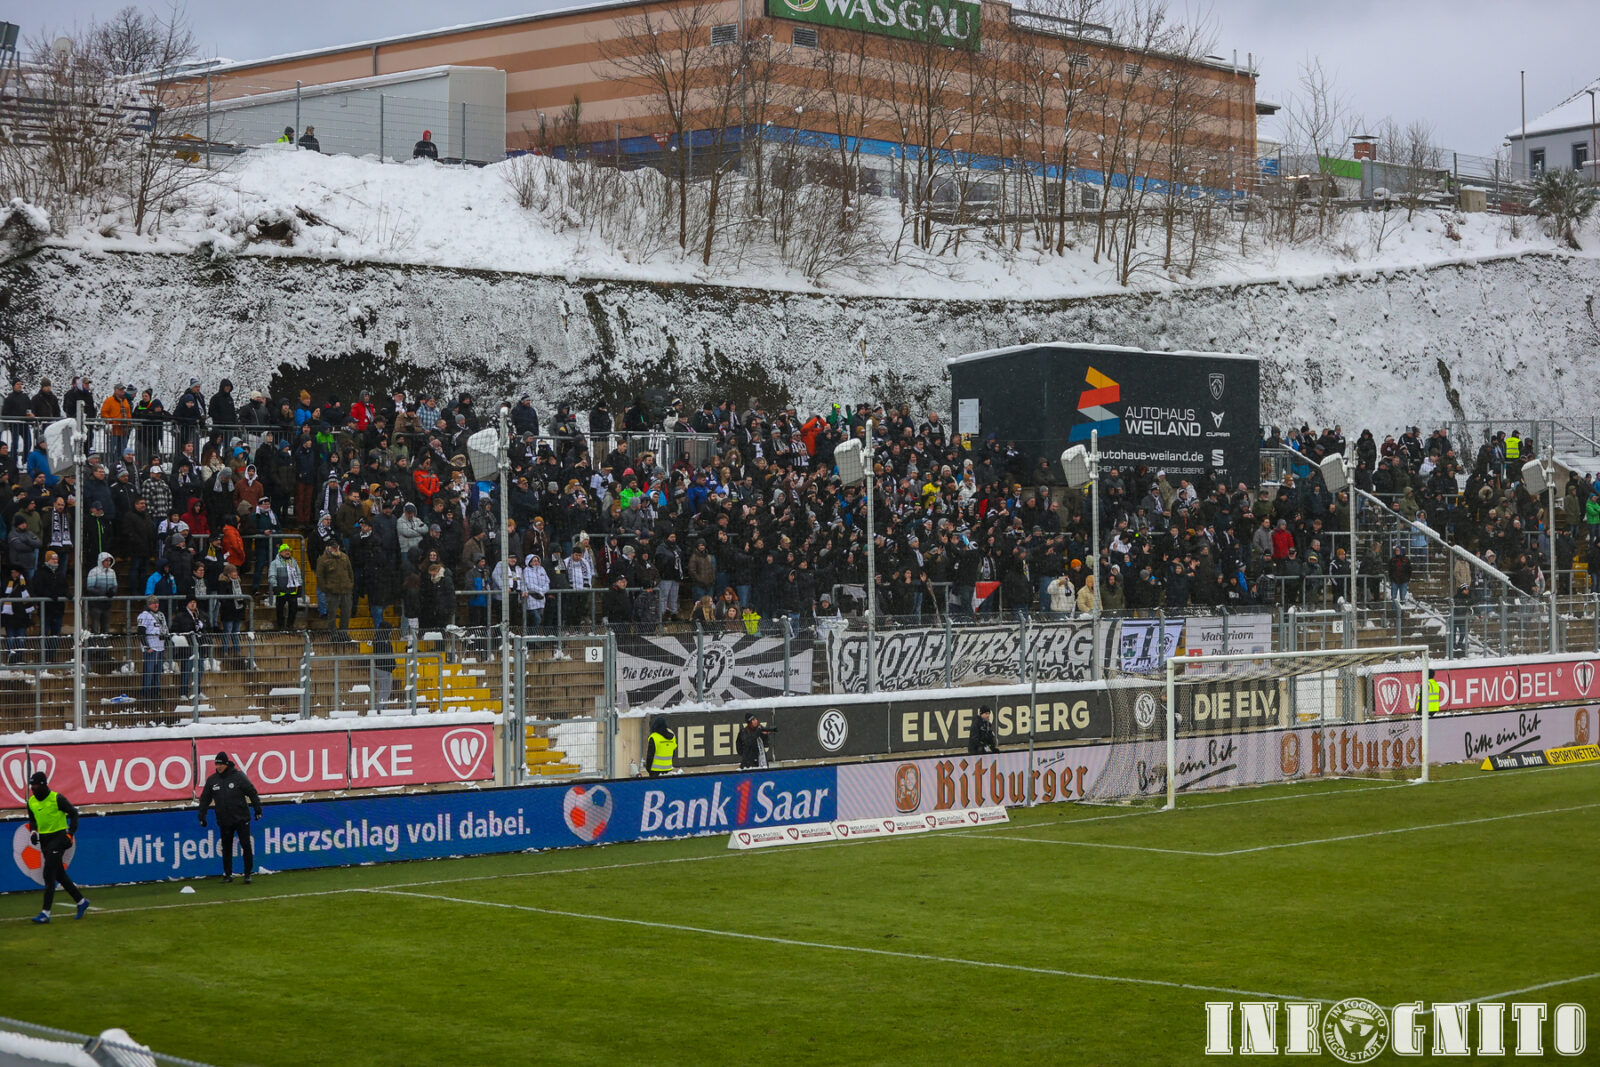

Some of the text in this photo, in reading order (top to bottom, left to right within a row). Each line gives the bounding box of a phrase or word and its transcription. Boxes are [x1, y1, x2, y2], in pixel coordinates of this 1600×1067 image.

[823, 0, 971, 40] WASGAU
[1124, 406, 1196, 421] AUTOHAUS
[1125, 420, 1201, 437] WEILAND
[591, 648, 598, 661] 9
[622, 666, 675, 680] Die Besten
[744, 668, 756, 679] im
[1194, 690, 1277, 721] DIE ELV.
[902, 700, 1090, 744] ELVESBERG
[1465, 712, 1542, 759] Bitte ein Bit
[1208, 738, 1237, 767] Bit
[1496, 753, 1543, 767] bwin bwin
[1550, 747, 1600, 763] SPORTWETTEN
[934, 757, 1088, 811] Bitburger
[640, 778, 829, 832] Bank 1 Saar
[119, 834, 165, 866] Mit
[264, 819, 399, 855] Herzschlag
[407, 813, 450, 844] voll
[459, 808, 531, 840] dabei.
